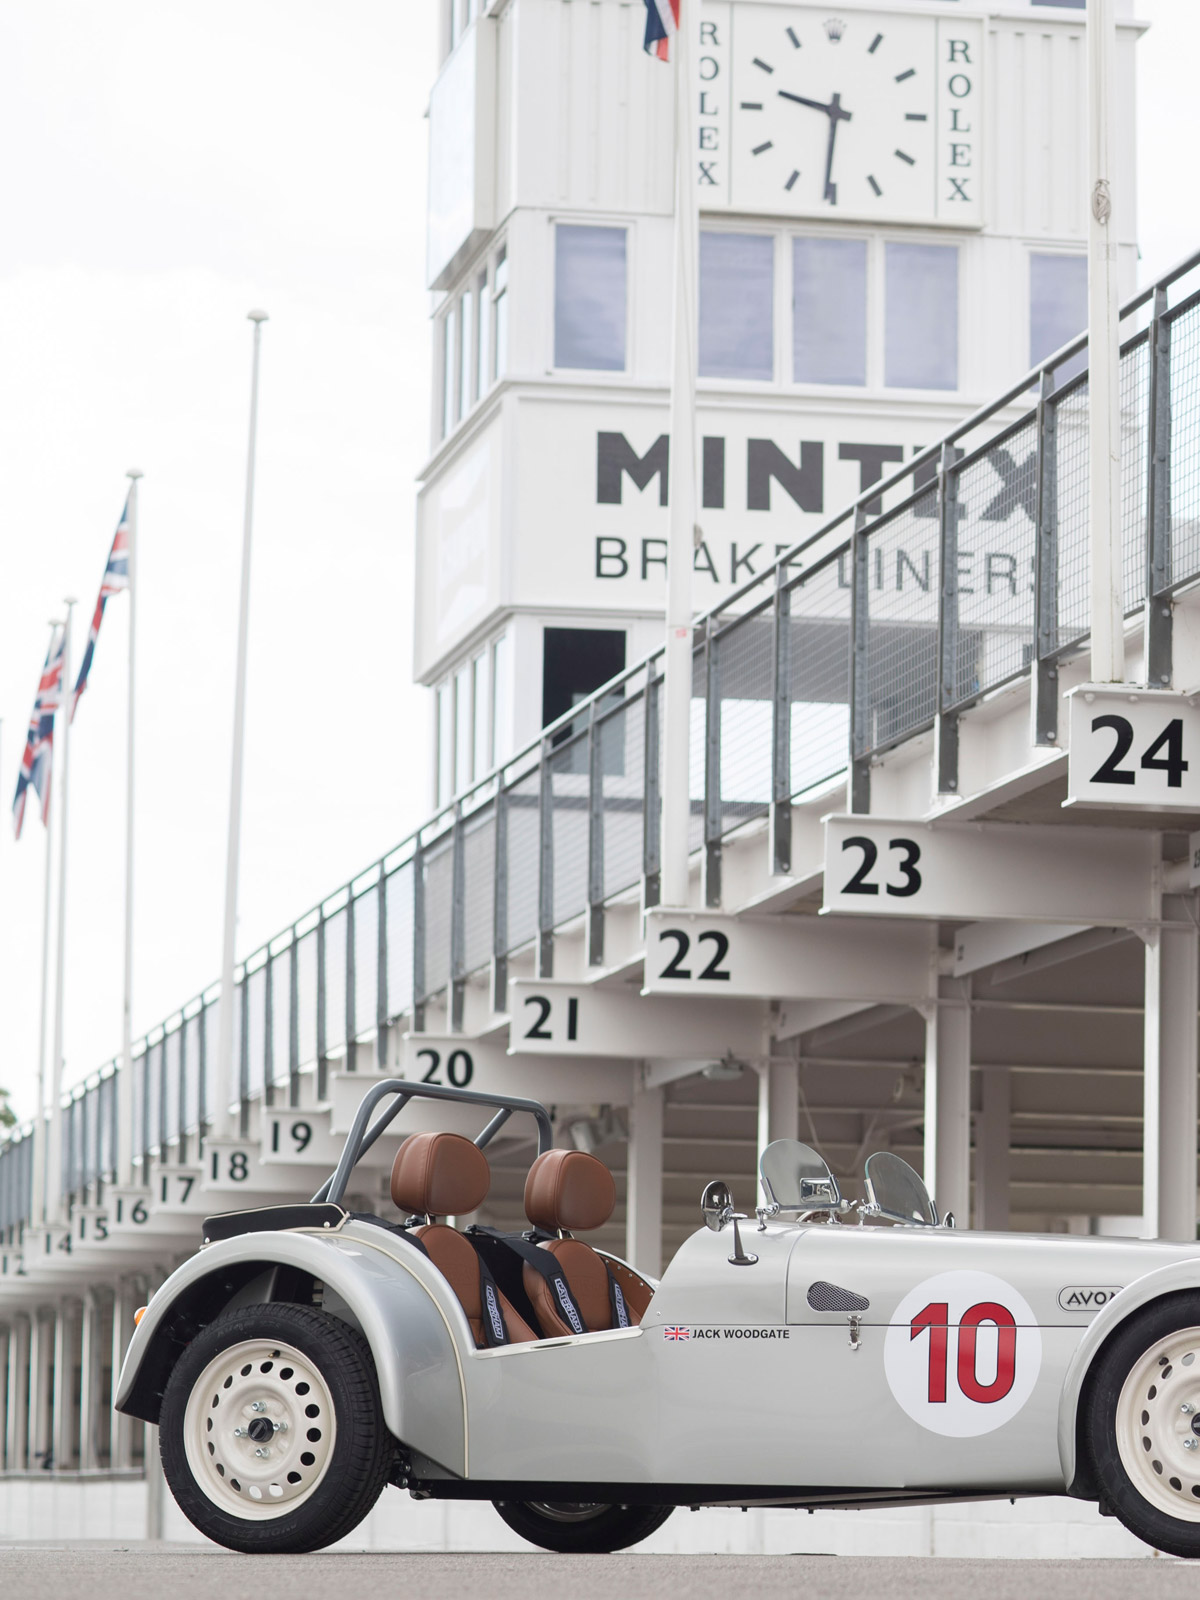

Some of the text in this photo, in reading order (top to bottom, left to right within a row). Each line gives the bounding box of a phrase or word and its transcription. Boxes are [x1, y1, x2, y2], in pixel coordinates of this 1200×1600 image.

[698, 21, 720, 186] ROLEX
[946, 39, 972, 201] ROLEX
[837, 547, 1050, 596] LINER
[1089, 714, 1188, 788] 24
[840, 836, 922, 897] 23
[658, 929, 731, 981] 22
[523, 996, 578, 1040] 21
[417, 1049, 473, 1088] 20
[272, 1121, 312, 1152] 19
[212, 1151, 248, 1181] 18
[161, 1176, 194, 1202] 17
[79, 1216, 108, 1241] 15
[116, 1198, 148, 1223] 16
[46, 1233, 72, 1254] 14
[3, 1255, 28, 1275] 12
[555, 1278, 582, 1333] CATERHAM
[692, 1329, 790, 1339] JACK WOODGATE
[910, 1302, 1017, 1404] 10
